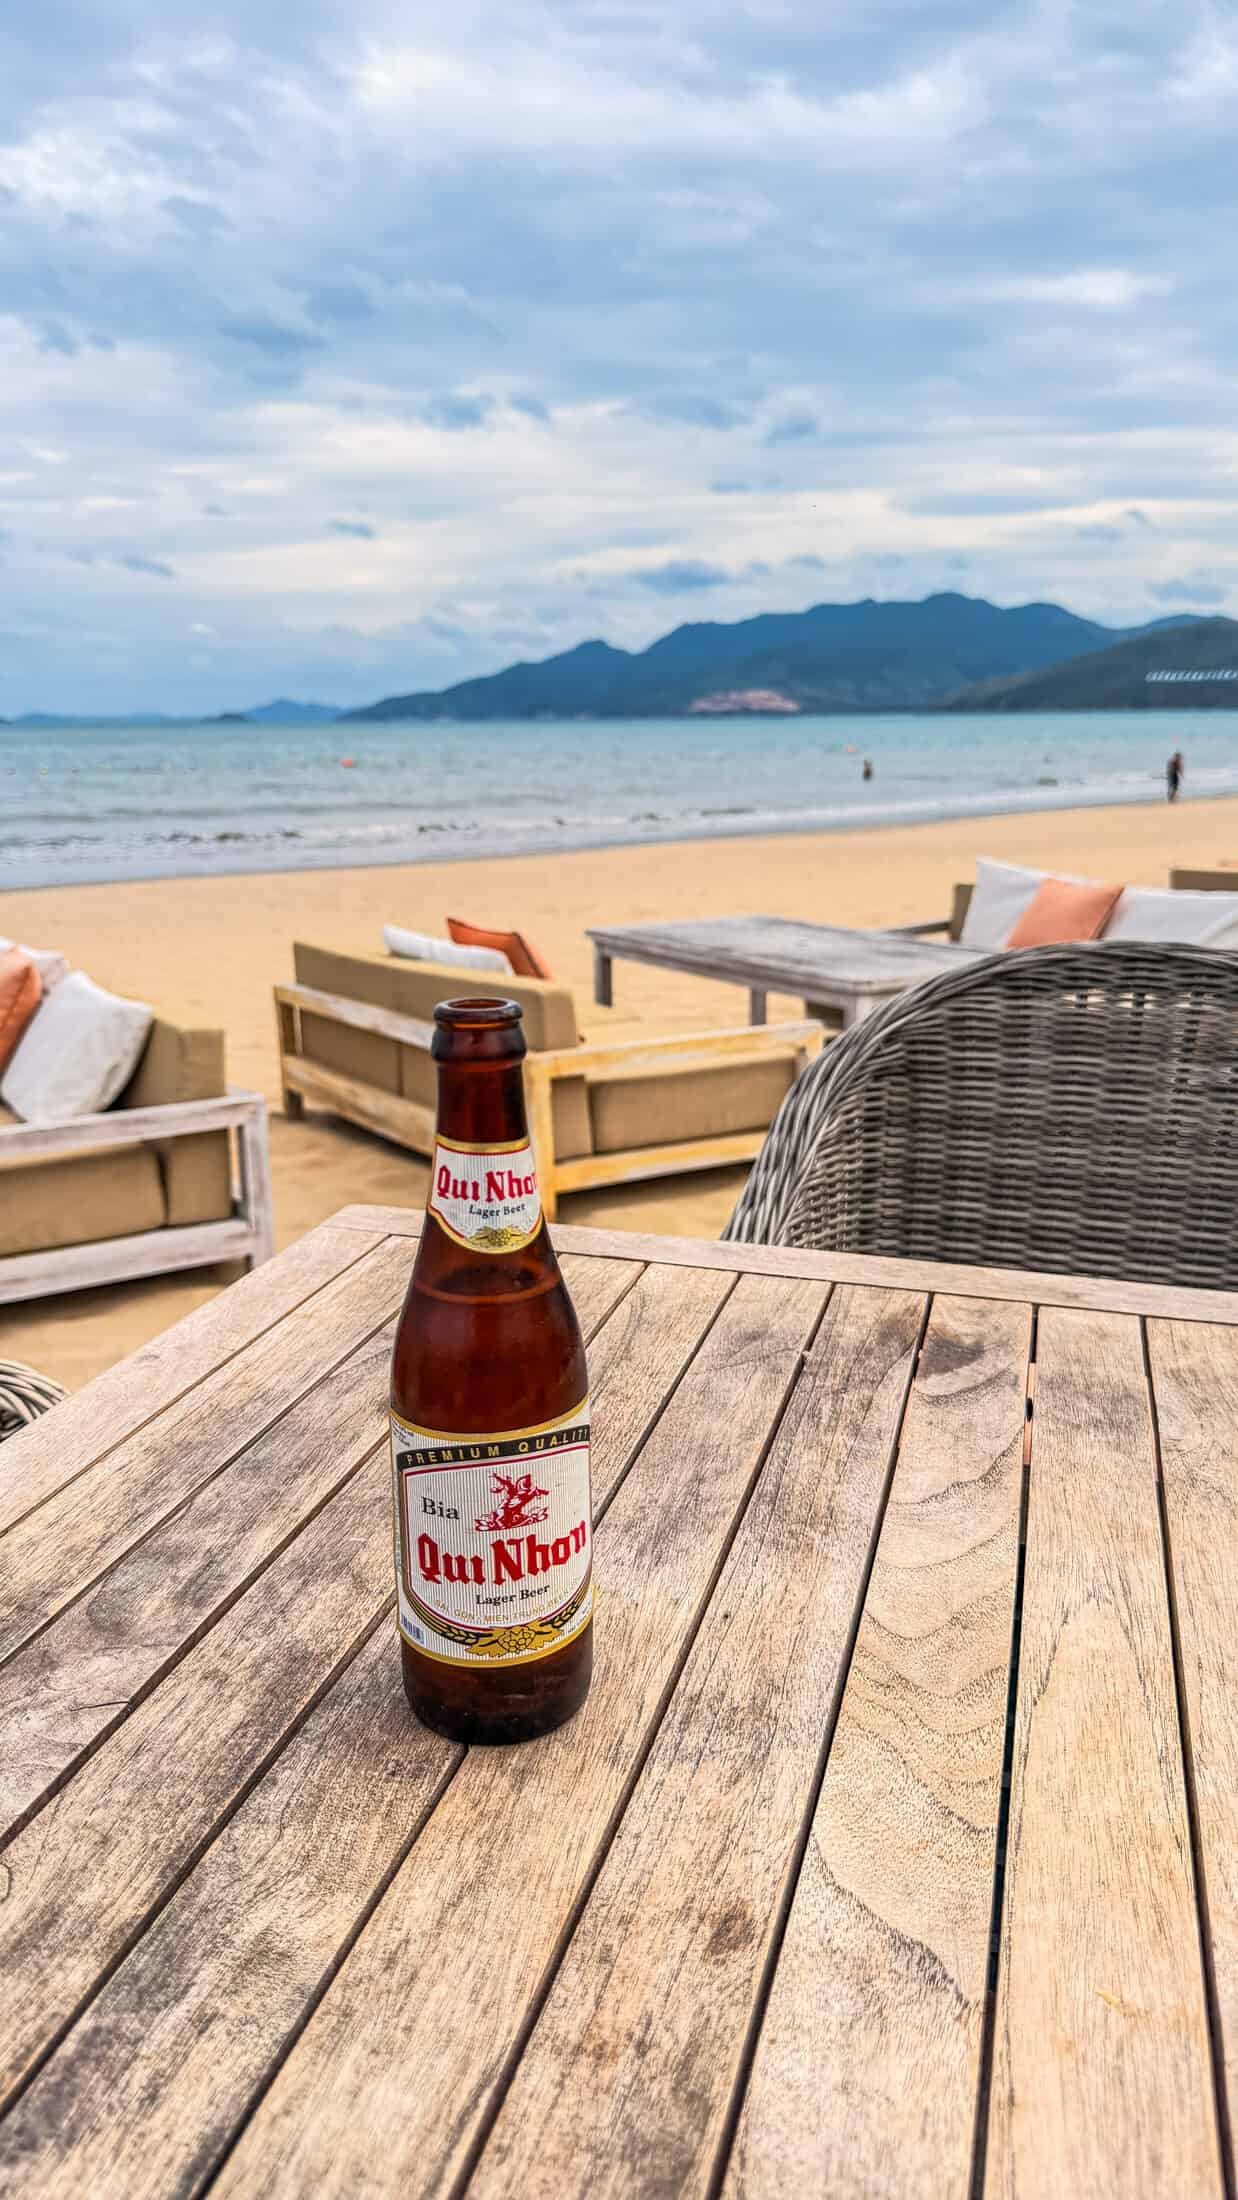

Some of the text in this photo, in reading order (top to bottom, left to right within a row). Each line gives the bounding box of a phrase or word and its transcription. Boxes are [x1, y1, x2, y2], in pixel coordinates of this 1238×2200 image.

[437, 1164, 480, 1202] Qui
[469, 1203, 526, 1220] Lager Beer
[406, 1446, 500, 1467] PREMIUM
[421, 1496, 460, 1520] Bia
[417, 1520, 587, 1586] Qui Nhon
[475, 1593, 517, 1607] Lager
[519, 1584, 550, 1600] Beer
